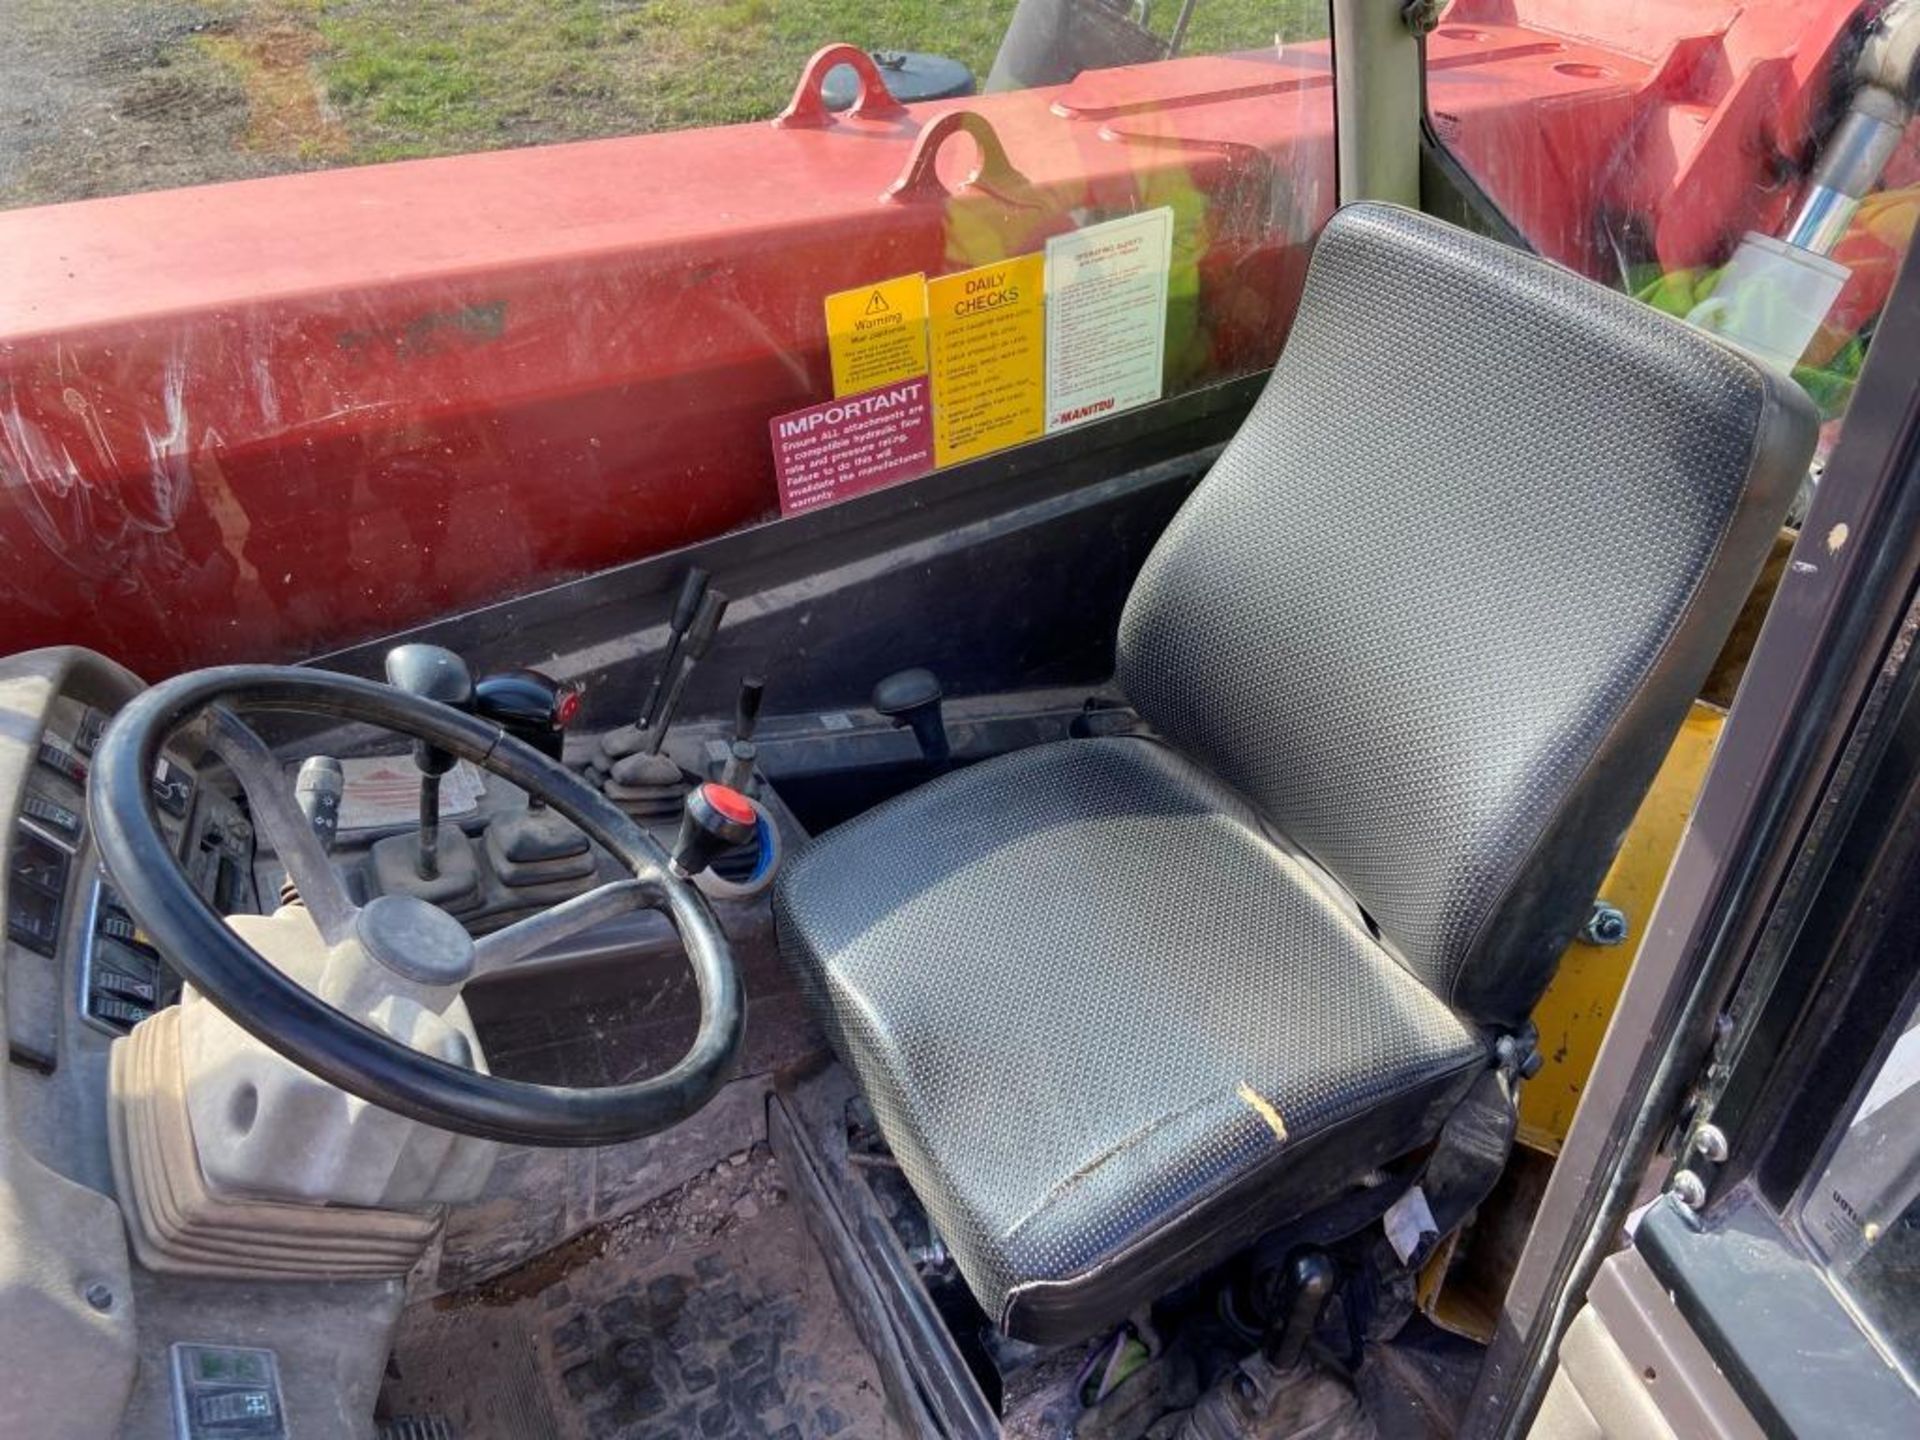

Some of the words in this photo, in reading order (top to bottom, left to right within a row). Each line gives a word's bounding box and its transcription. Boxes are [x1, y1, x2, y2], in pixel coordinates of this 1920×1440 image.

[954, 287, 1018, 315] CHECKS
[965, 272, 1006, 295] DAILY
[854, 311, 902, 331] Warning
[780, 384, 922, 438] IMPORTANT
[781, 435, 817, 452] Ensure
[819, 428, 840, 441] ALL
[842, 409, 905, 435] attachments
[908, 405, 924, 415] are
[1060, 398, 1115, 424] MANITOU
[783, 456, 791, 464] a
[793, 437, 850, 462] compatible
[852, 423, 897, 445] hydraulic
[900, 416, 921, 429] flow
[784, 463, 805, 476] rate
[808, 456, 828, 469] and
[831, 443, 875, 463] pressure
[786, 470, 820, 487] Failure
[822, 466, 834, 476] to
[837, 461, 851, 472] do
[853, 454, 872, 467] this
[876, 449, 892, 460] will
[788, 478, 835, 498] invalidate
[838, 472, 855, 483] the
[857, 450, 927, 477] manufacturers
